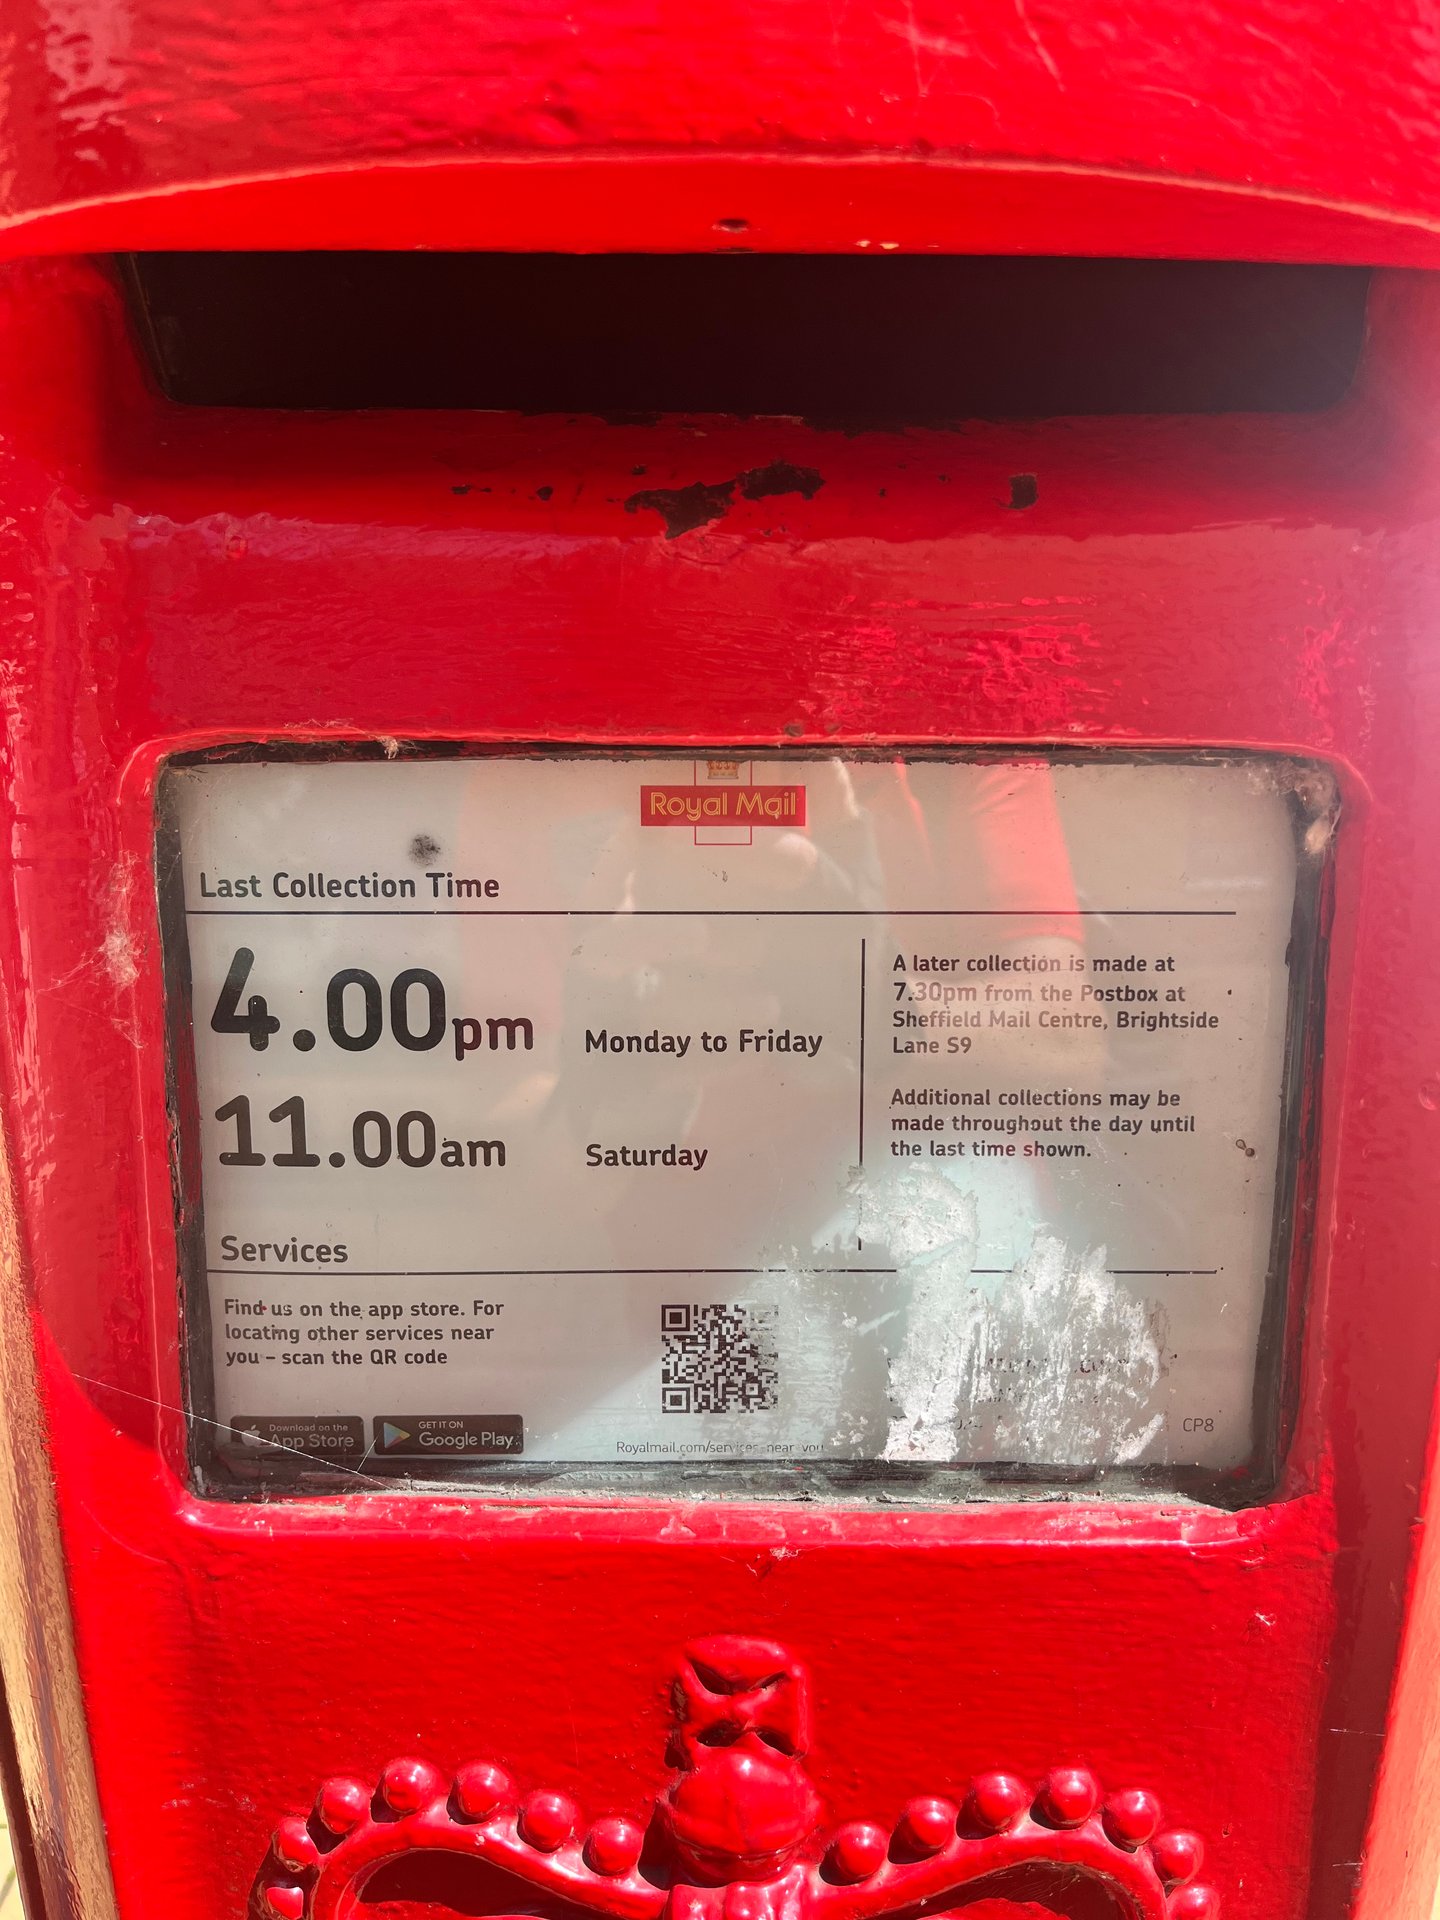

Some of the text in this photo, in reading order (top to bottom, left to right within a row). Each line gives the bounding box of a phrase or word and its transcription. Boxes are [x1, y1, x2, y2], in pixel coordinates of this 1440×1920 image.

[650, 791, 797, 824] Royal Mail
[200, 873, 500, 899] Last Collection Time
[893, 954, 1175, 972] A later collection is made at
[210, 946, 534, 1061] 4.00pm
[893, 982, 1186, 1005] 7.30pm from the Postbox at
[893, 1010, 1219, 1032] Sheffield Mail Centre, Brightside
[585, 1029, 823, 1058] Monday to Friday
[893, 1037, 972, 1054] Lane S9
[891, 1088, 1181, 1109] Additional collections may be
[214, 1094, 506, 1169] 11.00am
[891, 1115, 1195, 1135] made throughout the day until
[586, 1143, 709, 1171] Saturday
[891, 1140, 1091, 1157] the last time shown.
[220, 1235, 349, 1264] Services
[224, 1299, 504, 1320] Find us on the app store. For
[225, 1324, 494, 1343] locating other services near
[226, 1351, 259, 1366] you
[282, 1352, 324, 1364] scan
[331, 1350, 362, 1364] the
[370, 1349, 397, 1365] QR
[404, 1349, 447, 1364] code
[269, 1424, 316, 1432] Download
[333, 1423, 348, 1432] the
[418, 1420, 464, 1429] GET IT ON
[1182, 1417, 1215, 1433] CP8
[270, 1433, 355, 1449] App Store
[419, 1431, 514, 1449] Google Play
